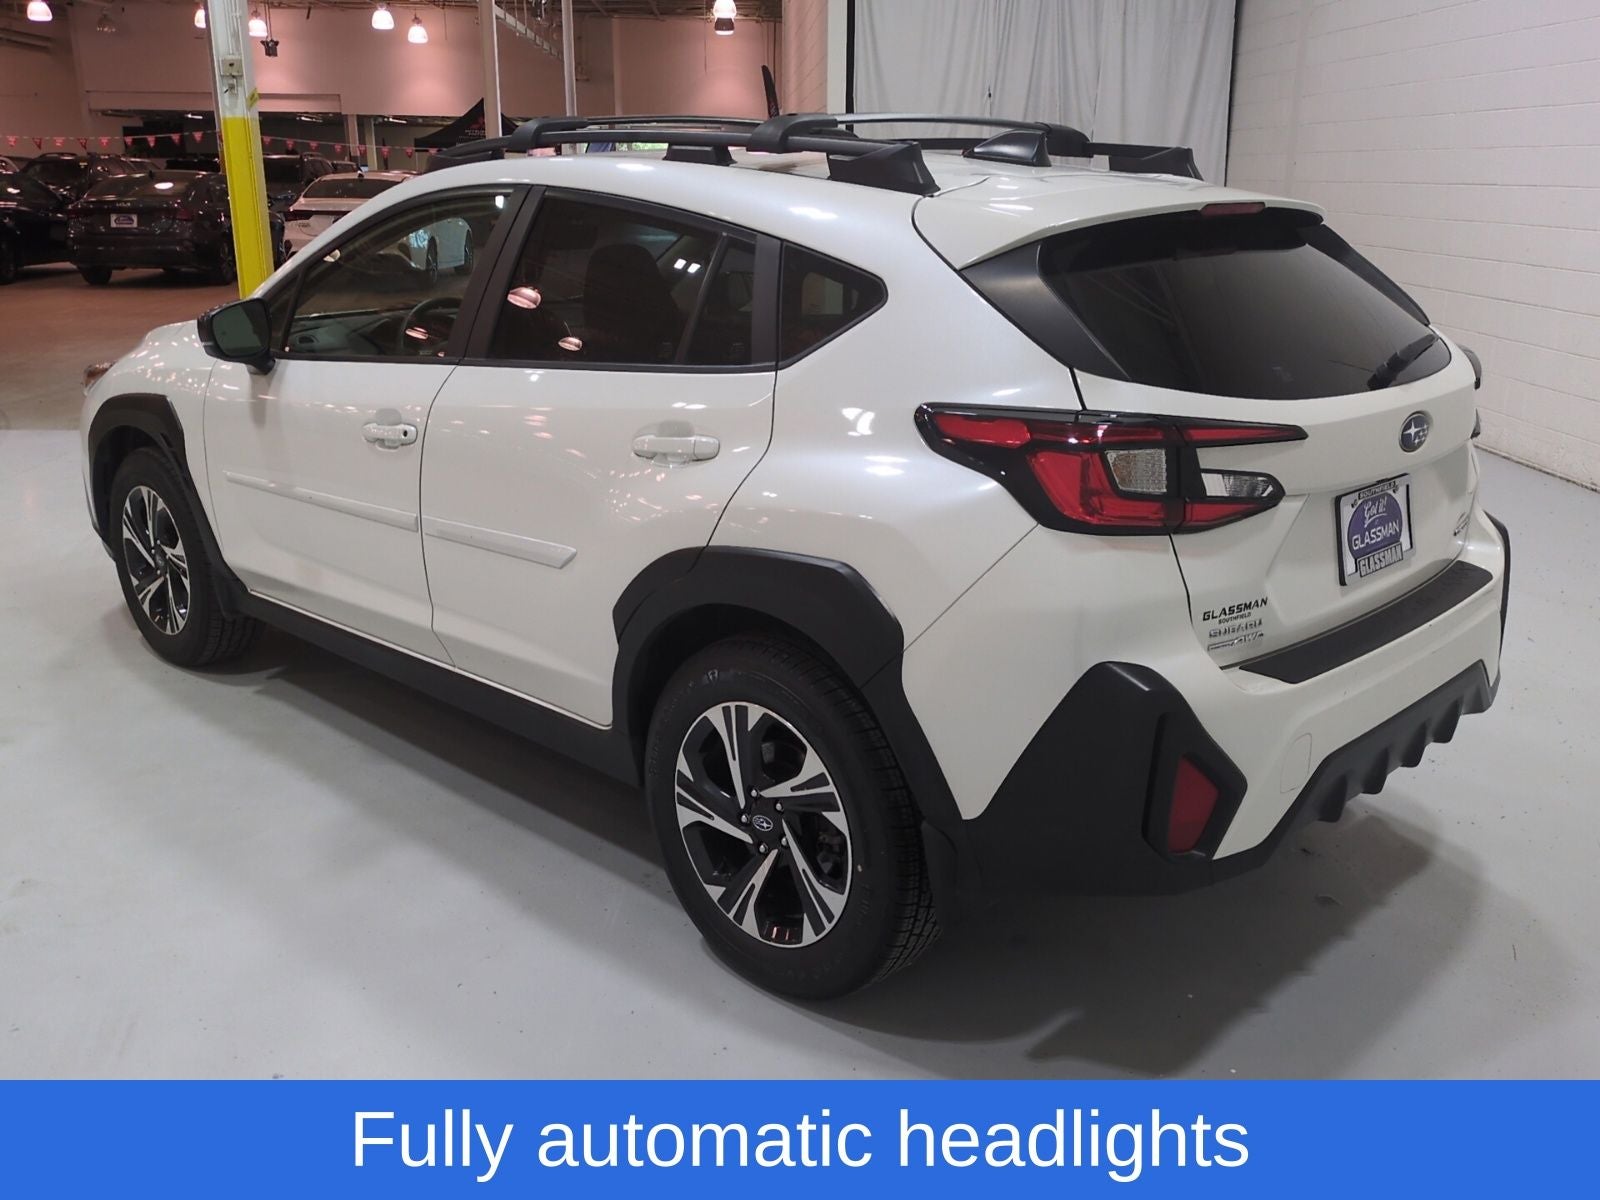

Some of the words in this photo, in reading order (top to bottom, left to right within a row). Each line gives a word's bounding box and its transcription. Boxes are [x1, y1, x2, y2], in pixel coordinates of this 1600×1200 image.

[1352, 520, 1399, 550] GLASSMAN
[1360, 543, 1402, 576] GLASSMAN
[1203, 597, 1268, 621] GLASSMAN
[1219, 612, 1251, 624] SOUTHFIELD
